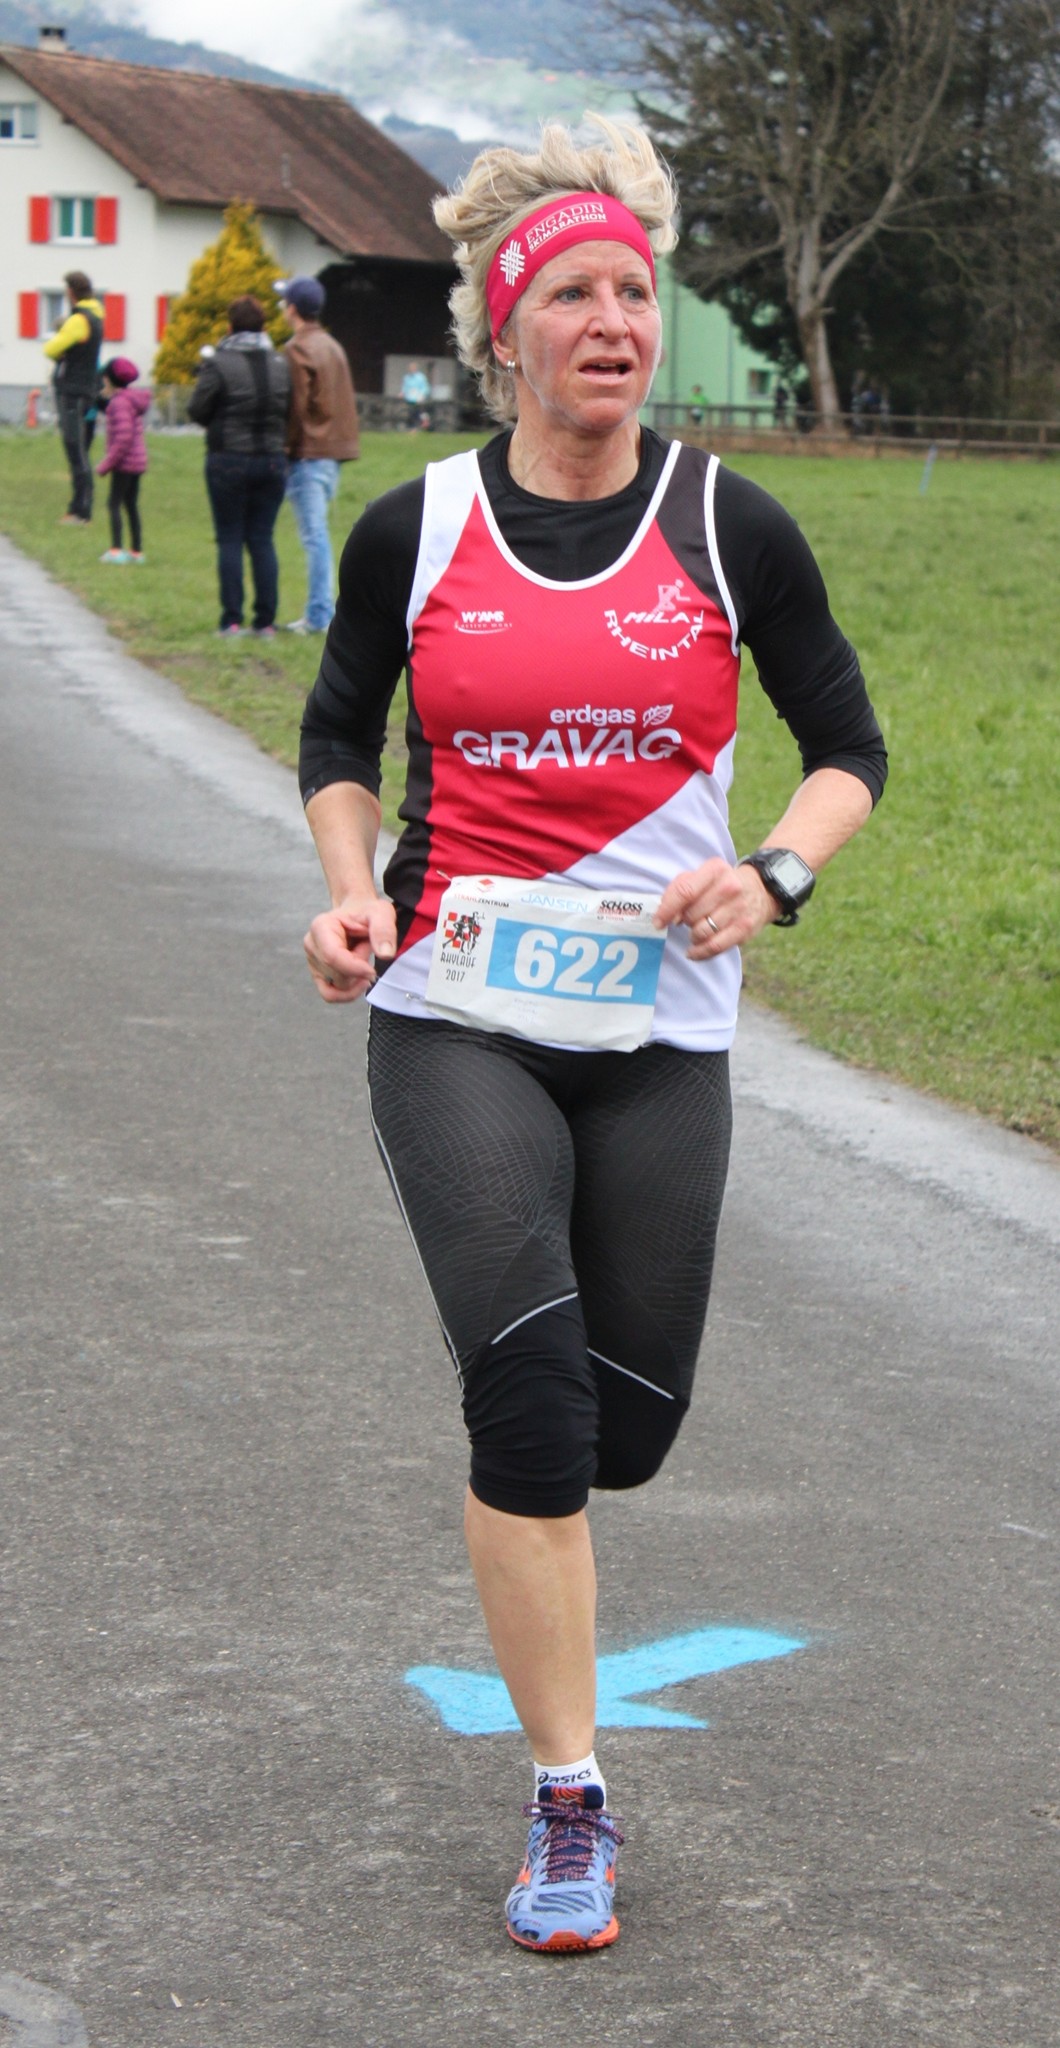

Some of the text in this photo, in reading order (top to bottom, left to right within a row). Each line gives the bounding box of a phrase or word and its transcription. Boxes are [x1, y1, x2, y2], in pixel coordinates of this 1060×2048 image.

[526, 203, 604, 245] ENGADIN
[529, 213, 607, 252] SKIMARATHON
[604, 609, 704, 661] RHEINTAL
[550, 704, 636, 726] erdgas
[452, 728, 682, 770] GRAVAG
[521, 893, 589, 913] JANSEN
[600, 899, 643, 912] SCHLOSS
[445, 969, 466, 982] 2017
[514, 929, 640, 998] 622
